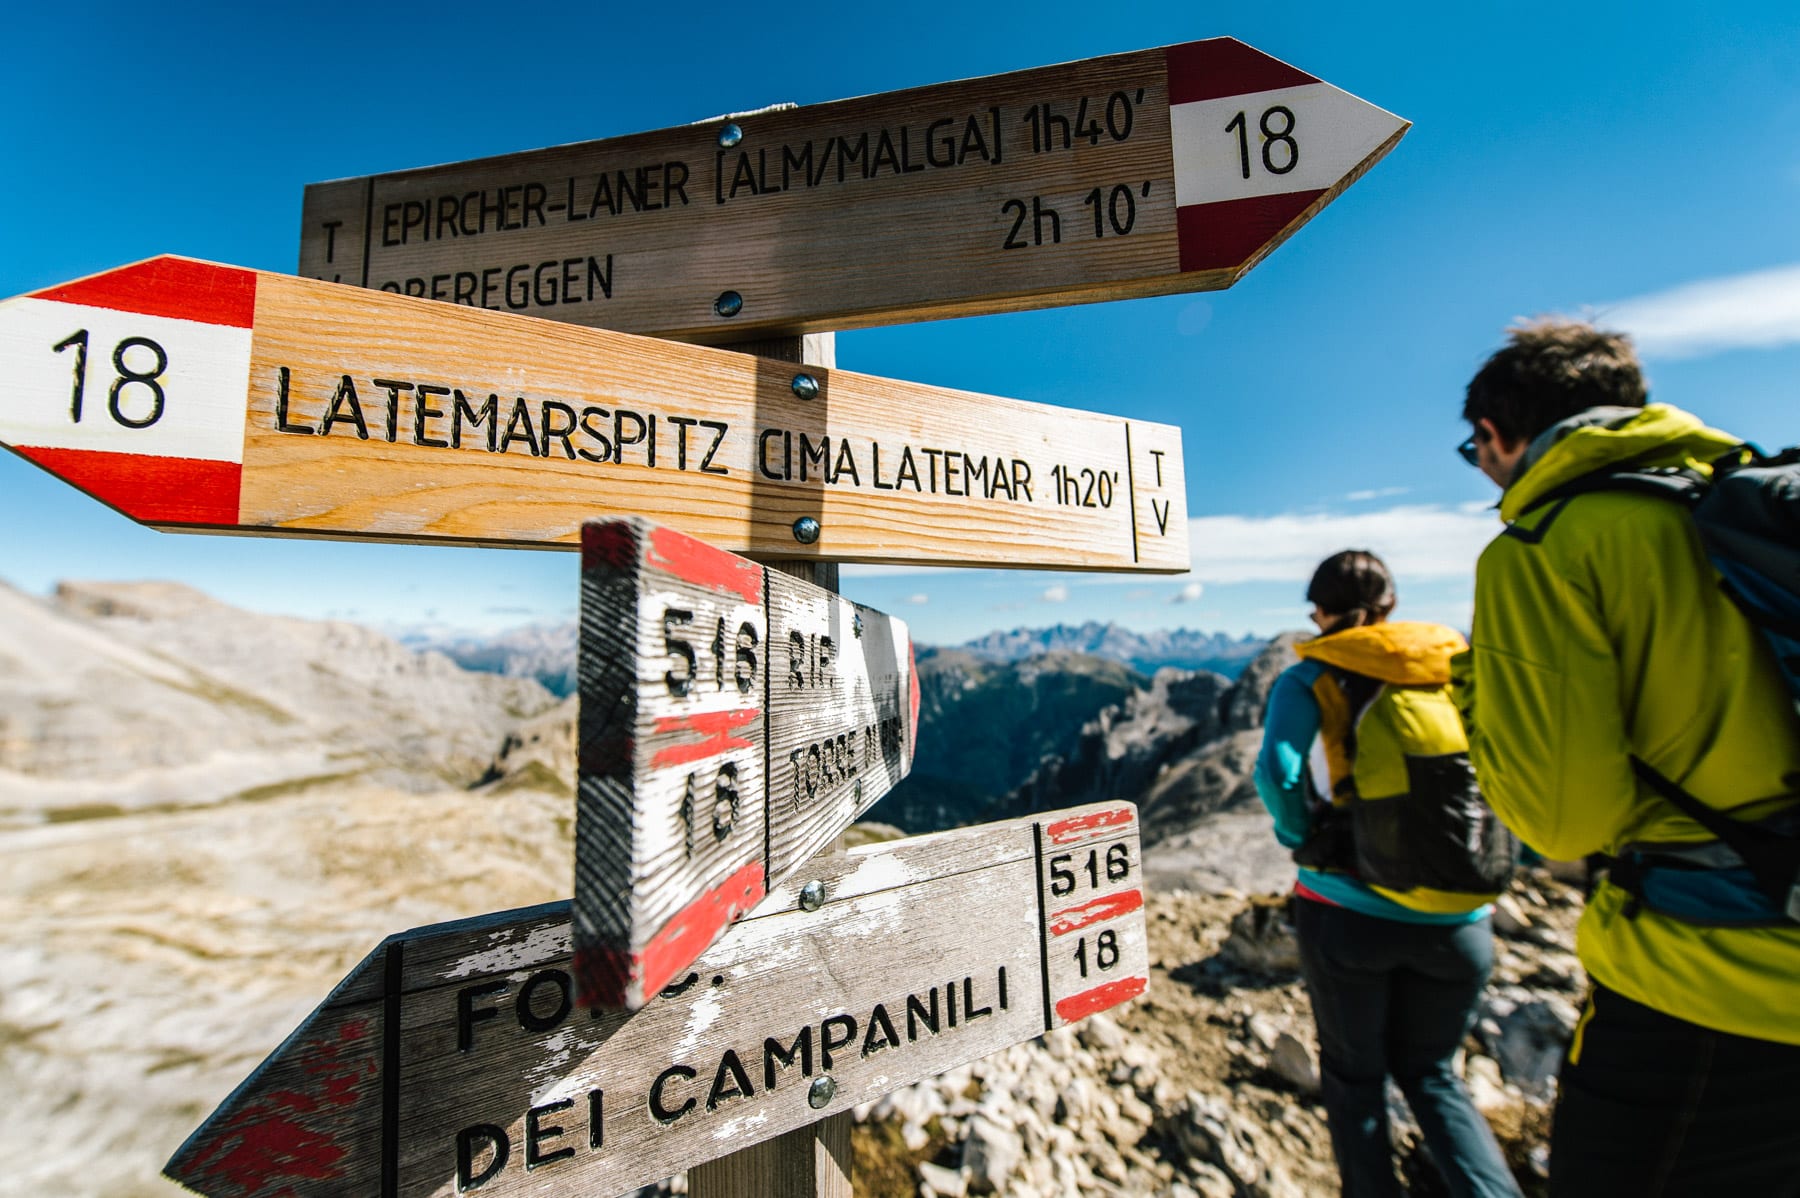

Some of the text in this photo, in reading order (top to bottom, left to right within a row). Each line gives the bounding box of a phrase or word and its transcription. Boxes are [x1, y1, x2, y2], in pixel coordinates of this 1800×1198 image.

[382, 88, 1146, 247] EPIRCHER-LANER [ALM/MALGA] 1h40'
[1225, 105, 1299, 179] 18
[322, 221, 343, 263] T
[1001, 197, 1062, 250] 2h
[1085, 181, 1152, 239] 10'
[53, 329, 169, 429] 18
[274, 366, 1119, 509] LATEMARSPITZ CIMA LATEMAR 1h20'
[1150, 450, 1165, 488] T
[1151, 498, 1170, 537] V
[663, 607, 759, 698] 516
[680, 761, 741, 860] 18
[1050, 842, 1130, 898] 516
[1073, 929, 1120, 978] 18
[457, 968, 725, 1053] FO.
[456, 965, 1009, 1194] DEI CAMPANILI
